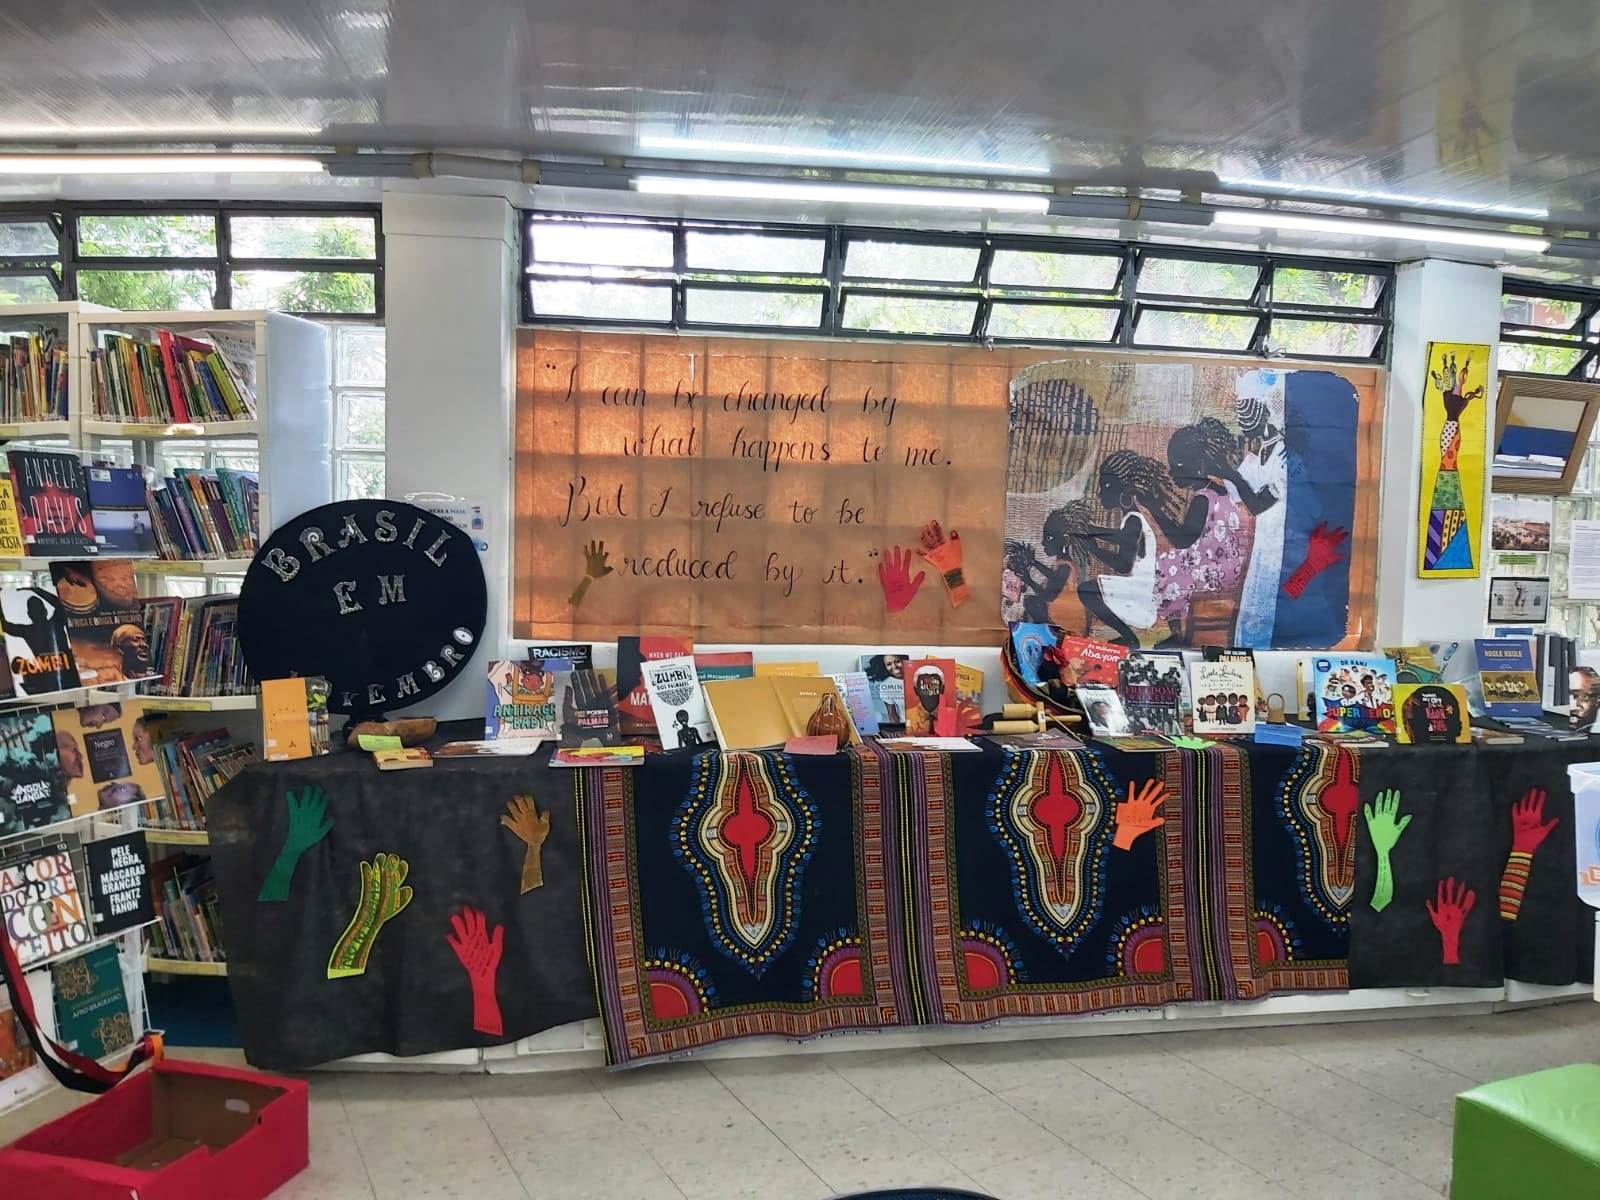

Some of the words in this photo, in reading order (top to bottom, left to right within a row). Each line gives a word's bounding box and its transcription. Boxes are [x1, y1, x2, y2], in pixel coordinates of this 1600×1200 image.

[602, 386, 646, 407] can
[674, 379, 700, 409] be
[723, 380, 833, 425] changed
[863, 386, 898, 427] by
[624, 425, 697, 456] what
[732, 426, 831, 473] happens
[863, 437, 884, 463] to
[905, 446, 952, 467] me.
[24, 457, 79, 488] ANGELA
[558, 475, 628, 528] But
[650, 486, 673, 518] I
[691, 493, 767, 533] refuse
[788, 500, 818, 524] to
[836, 498, 866, 525] be
[29, 495, 87, 535] DAVIS
[261, 510, 453, 583] BRASIL
[618, 548, 738, 580] reduced
[765, 552, 800, 597] by
[332, 574, 408, 615] EM
[533, 646, 588, 658] RACISMO
[1080, 648, 1121, 663] Abayom
[15, 653, 71, 676] ZUMBI
[654, 670, 688, 684] ZUMBI
[1125, 686, 1176, 696] FREEDOM
[512, 716, 546, 730] BABY
[94, 738, 116, 750] Negro
[110, 844, 131, 859] PELE
[112, 853, 143, 870] NEGRA,
[1, 870, 16, 893] A
[100, 864, 147, 885] MÁSCARAS
[102, 877, 141, 896] BRANCAS
[110, 887, 141, 905] FRANTZ
[111, 899, 139, 916] FANON
